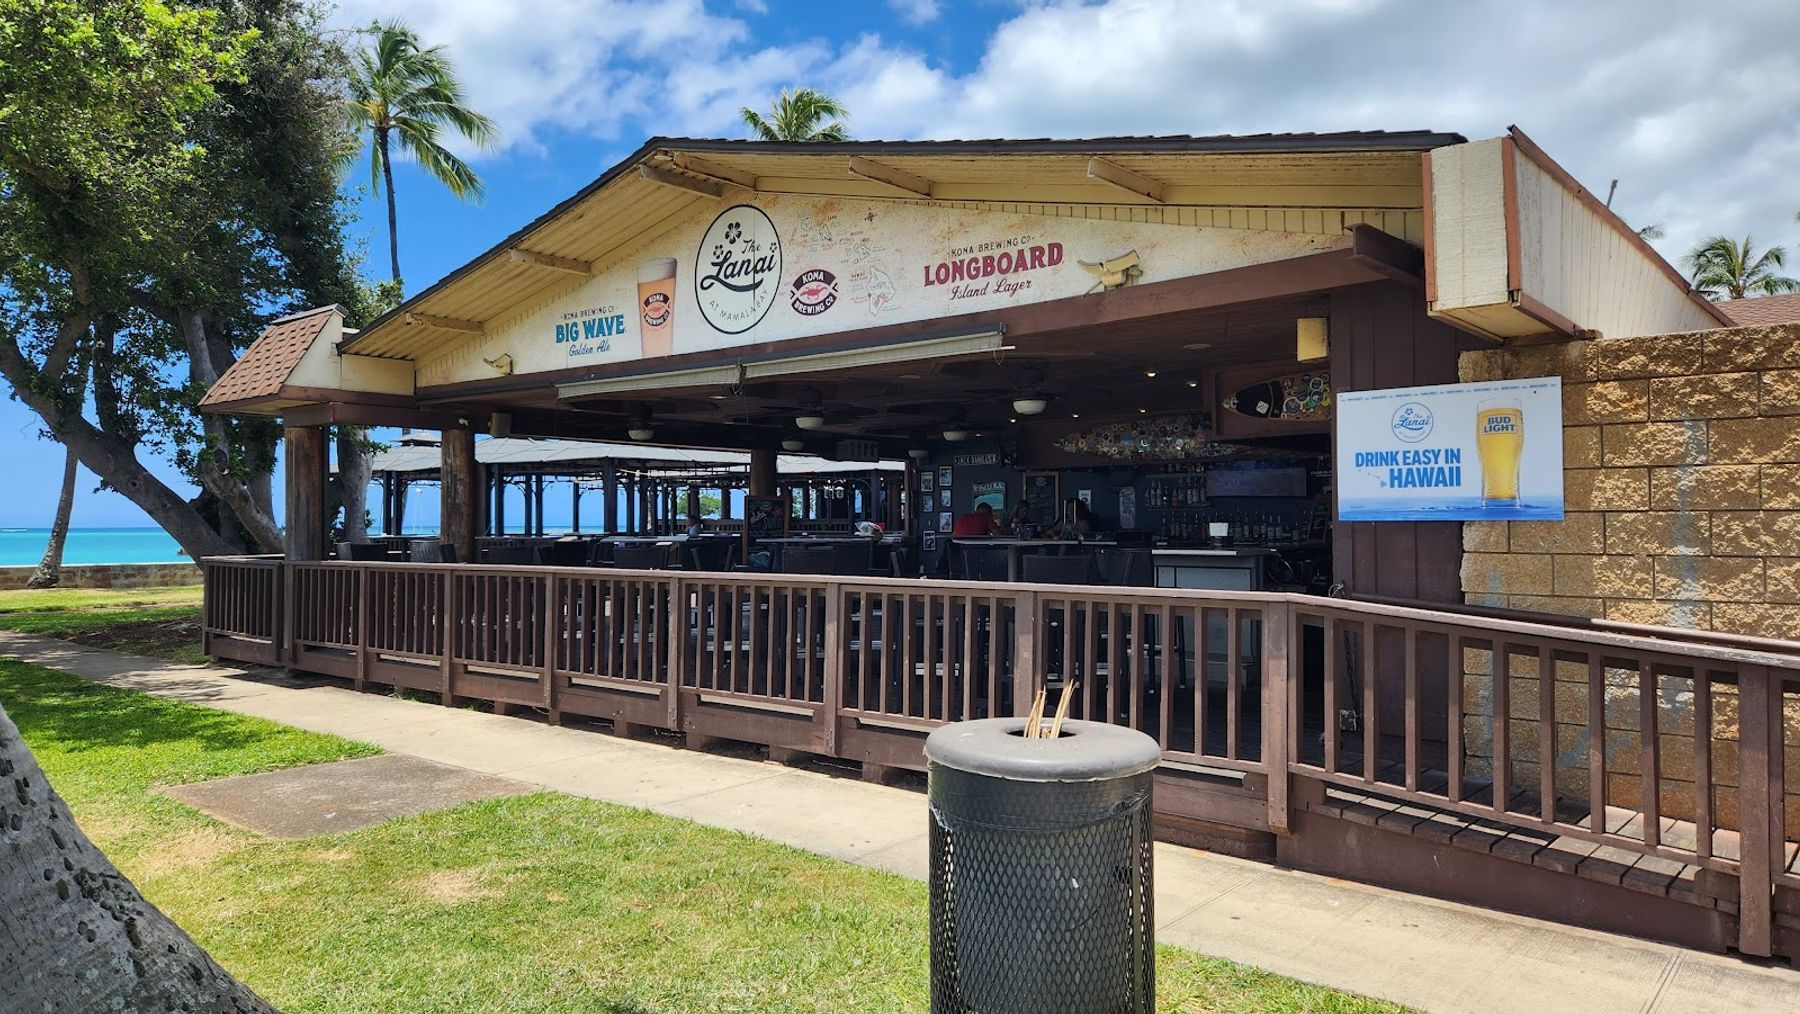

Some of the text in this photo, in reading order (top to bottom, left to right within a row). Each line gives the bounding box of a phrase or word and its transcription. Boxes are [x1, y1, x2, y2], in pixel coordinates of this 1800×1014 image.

[742, 239, 761, 254] The
[951, 246, 974, 257] KONA
[978, 237, 1019, 253] BREWING
[700, 250, 778, 293] Lanai
[924, 242, 1063, 287] LONGBOARD
[802, 270, 824, 284] KONA
[950, 278, 1032, 301] Island Lager
[794, 300, 826, 315] BREWING
[556, 314, 625, 344] BIG WAVE
[569, 339, 610, 356] Golden Ale
[1394, 417, 1431, 430] Lanai
[1483, 424, 1515, 434] LIGHT
[1487, 416, 1511, 425] BUD
[1355, 448, 1461, 467] DRINK EASY IN
[1390, 466, 1461, 488] HAWAII
